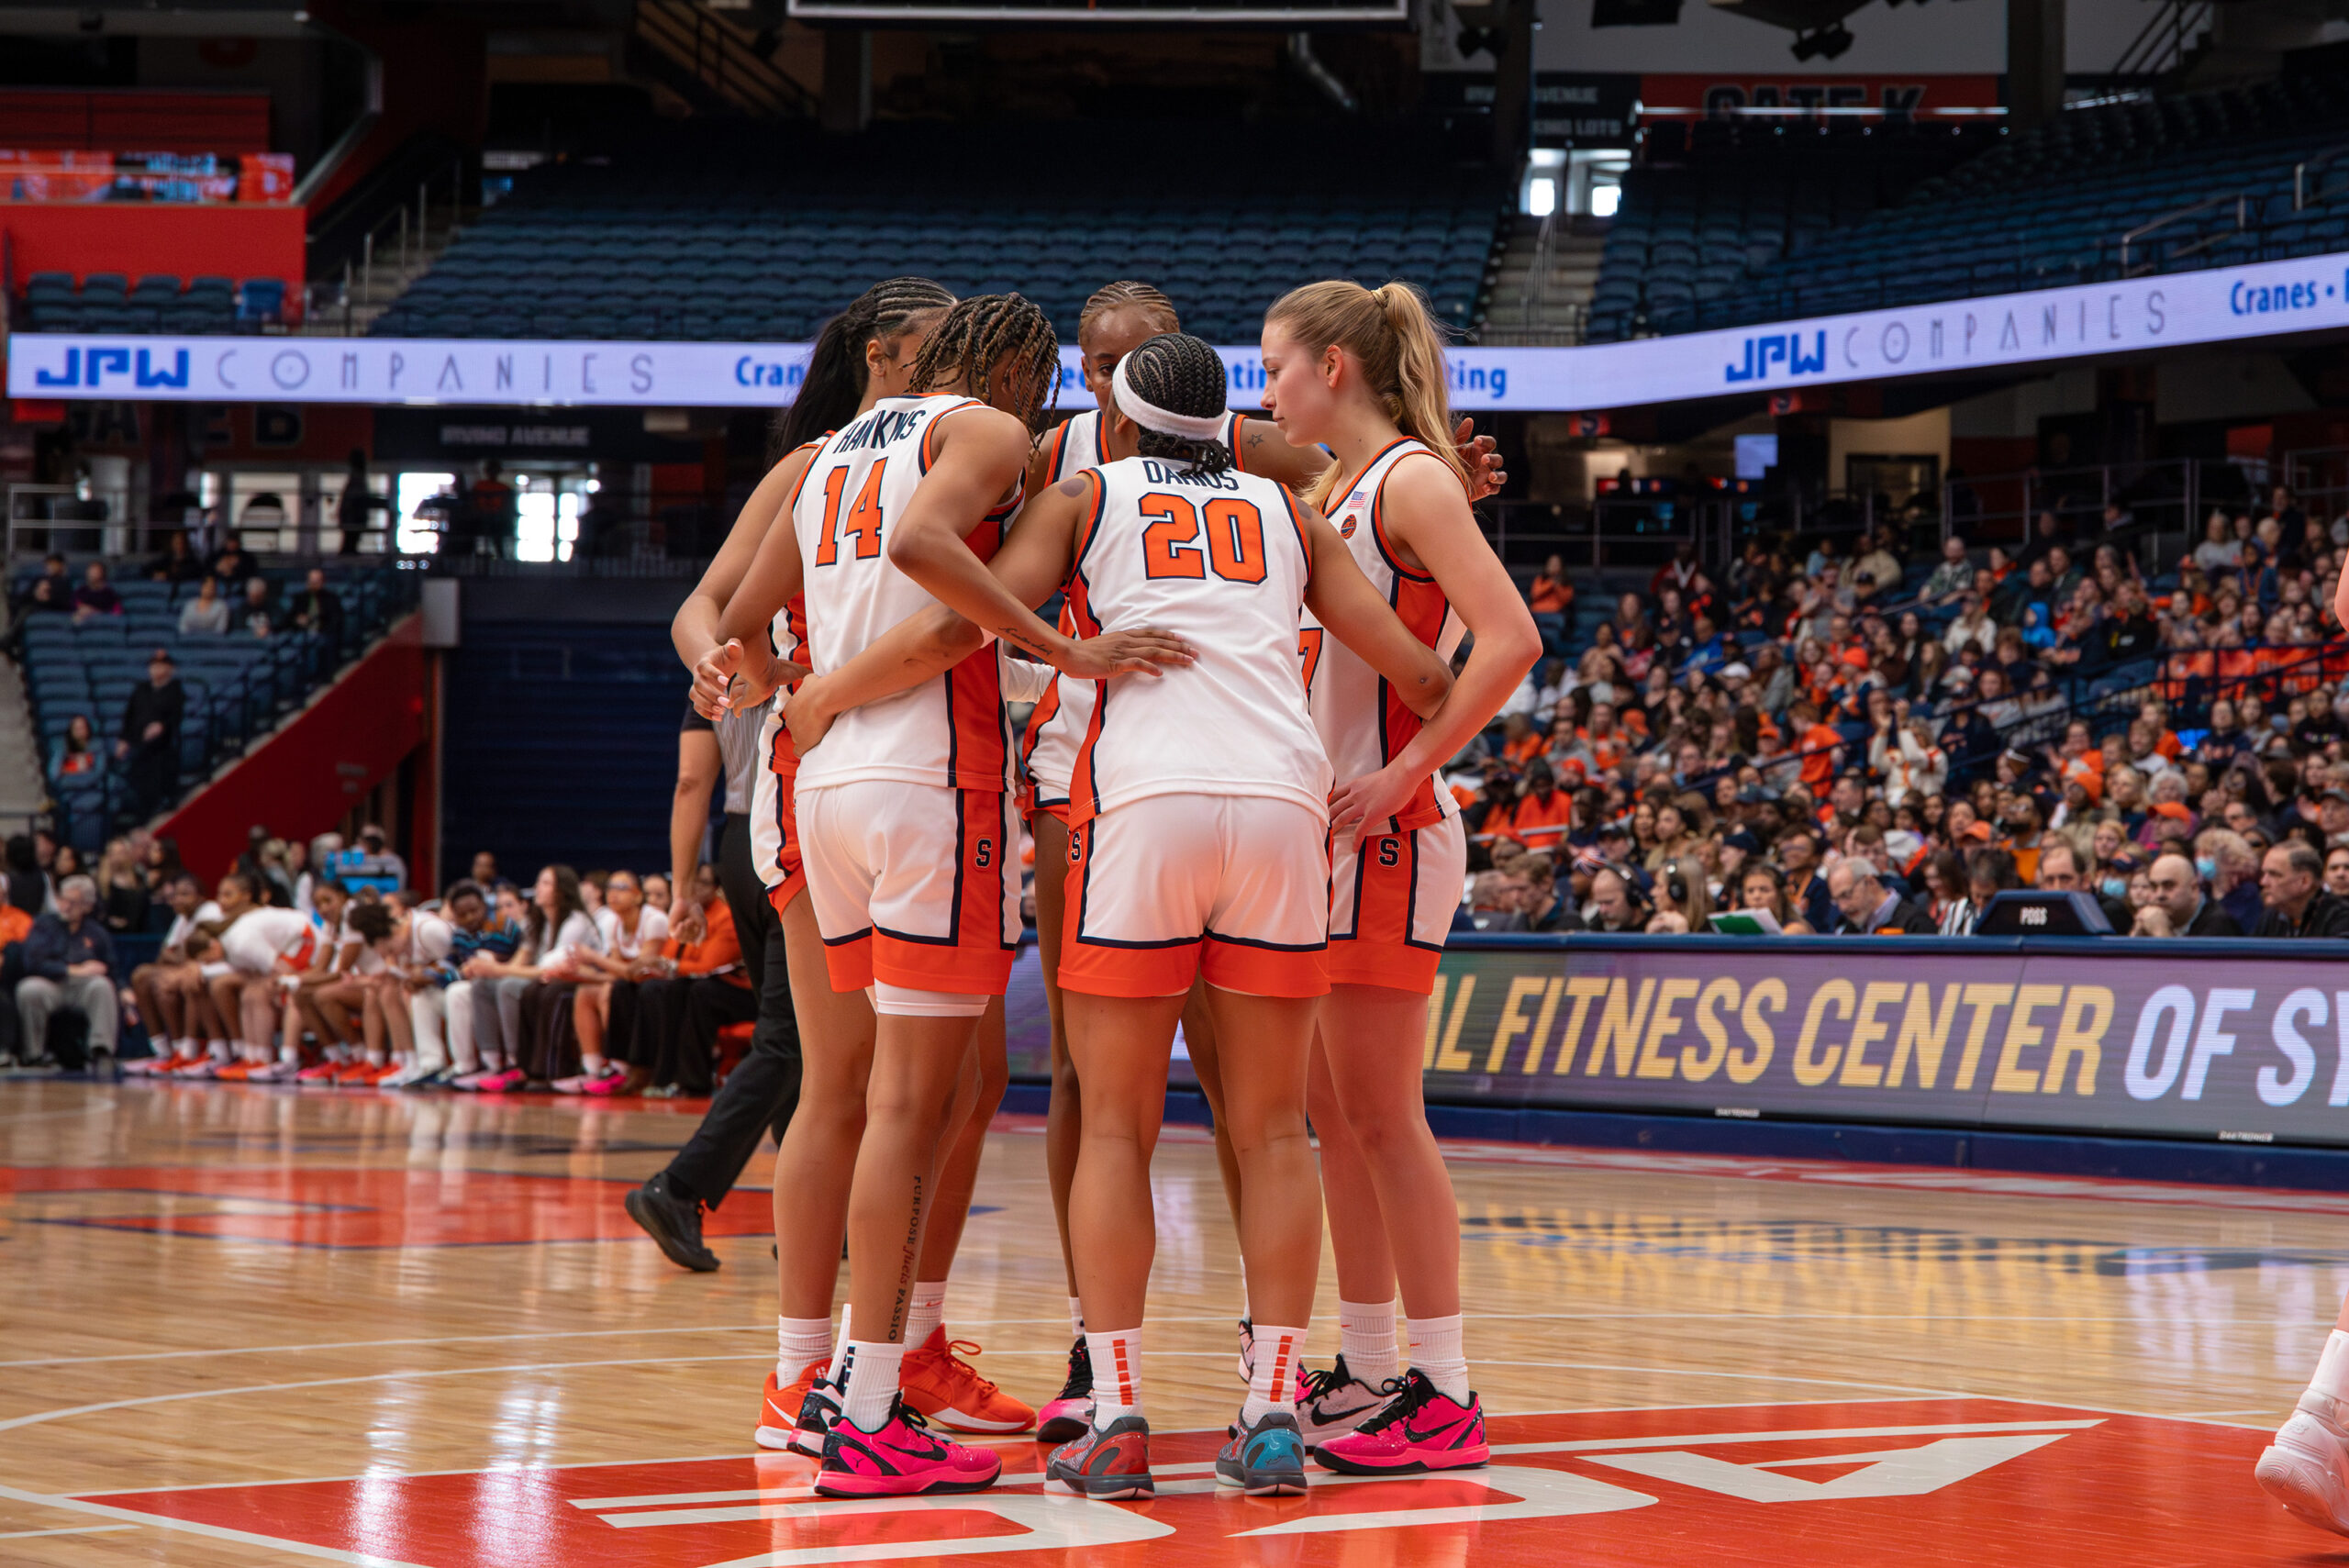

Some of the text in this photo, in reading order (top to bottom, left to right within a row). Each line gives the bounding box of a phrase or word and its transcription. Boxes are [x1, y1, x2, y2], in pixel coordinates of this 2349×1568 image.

[1726, 280, 2317, 384] JPW COMPANIES Cranes
[36, 347, 189, 388] JPW
[217, 349, 654, 395] COMPANIES
[815, 456, 889, 567] 14
[1138, 492, 1268, 585] 20
[975, 839, 992, 867] S
[1071, 831, 1082, 862] S
[1378, 837, 1401, 867] S
[1486, 975, 1788, 1084] FITNESS
[1793, 978, 2115, 1095] CENTER
[2124, 984, 2256, 1101] OF
